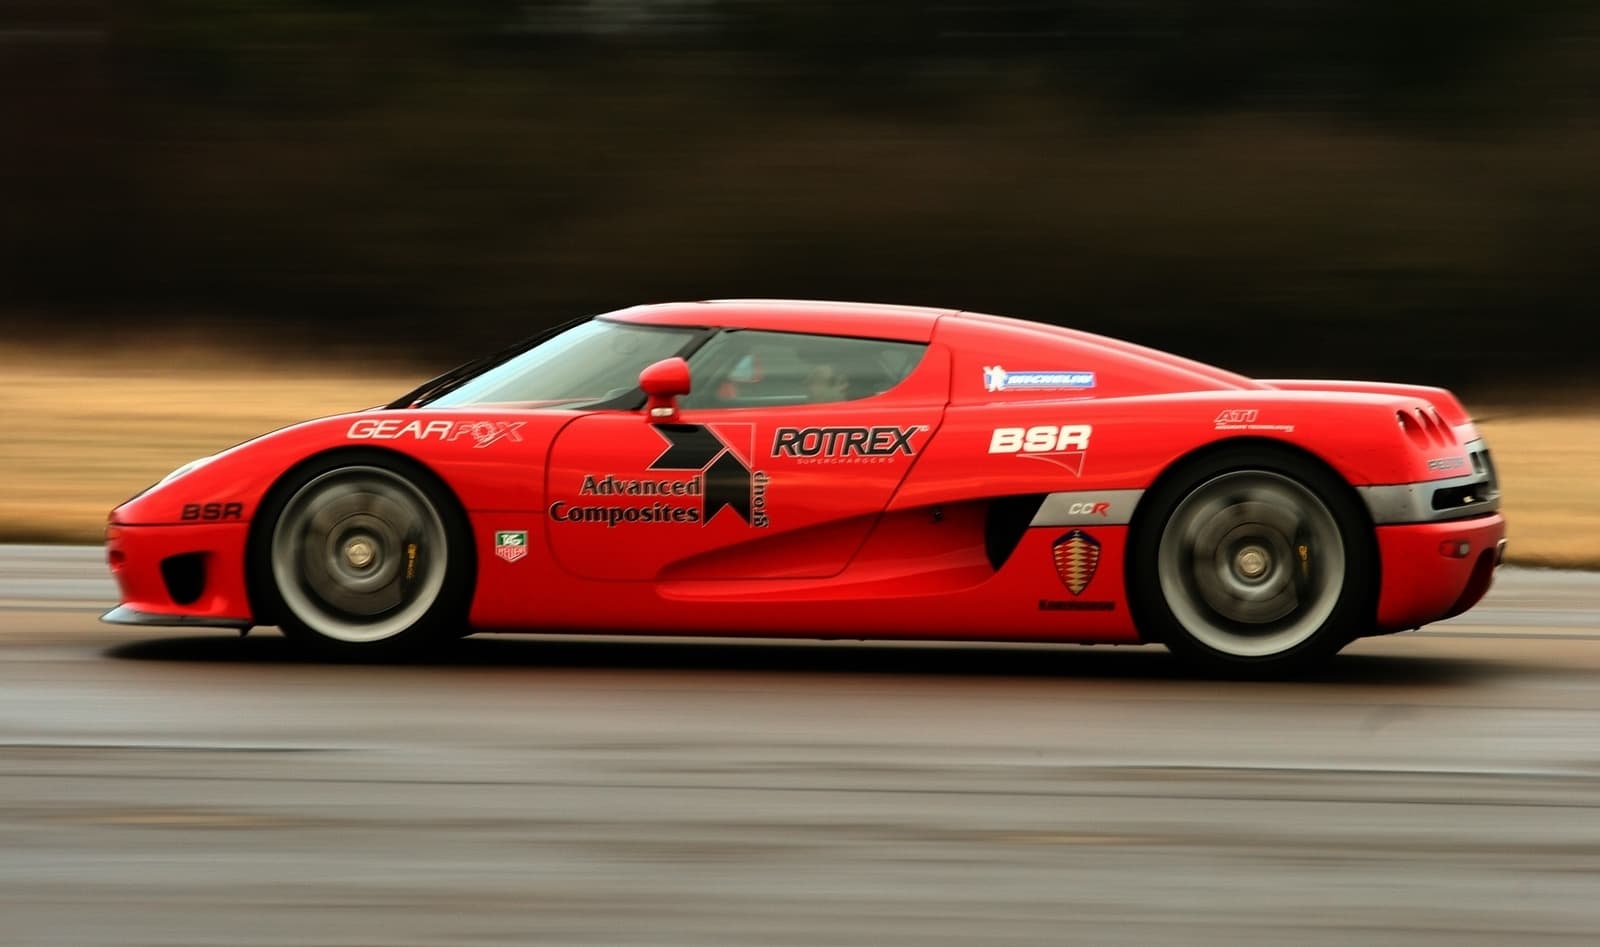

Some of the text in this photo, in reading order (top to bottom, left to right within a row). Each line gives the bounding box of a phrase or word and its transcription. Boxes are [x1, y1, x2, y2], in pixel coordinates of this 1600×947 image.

[1214, 409, 1258, 422] ATI
[770, 425, 916, 458] ROTREX
[988, 424, 1093, 454] BSR
[579, 474, 702, 496] Advanced
[181, 502, 243, 520] BSR
[550, 500, 700, 528] Composites
[1068, 502, 1111, 518] CCR
